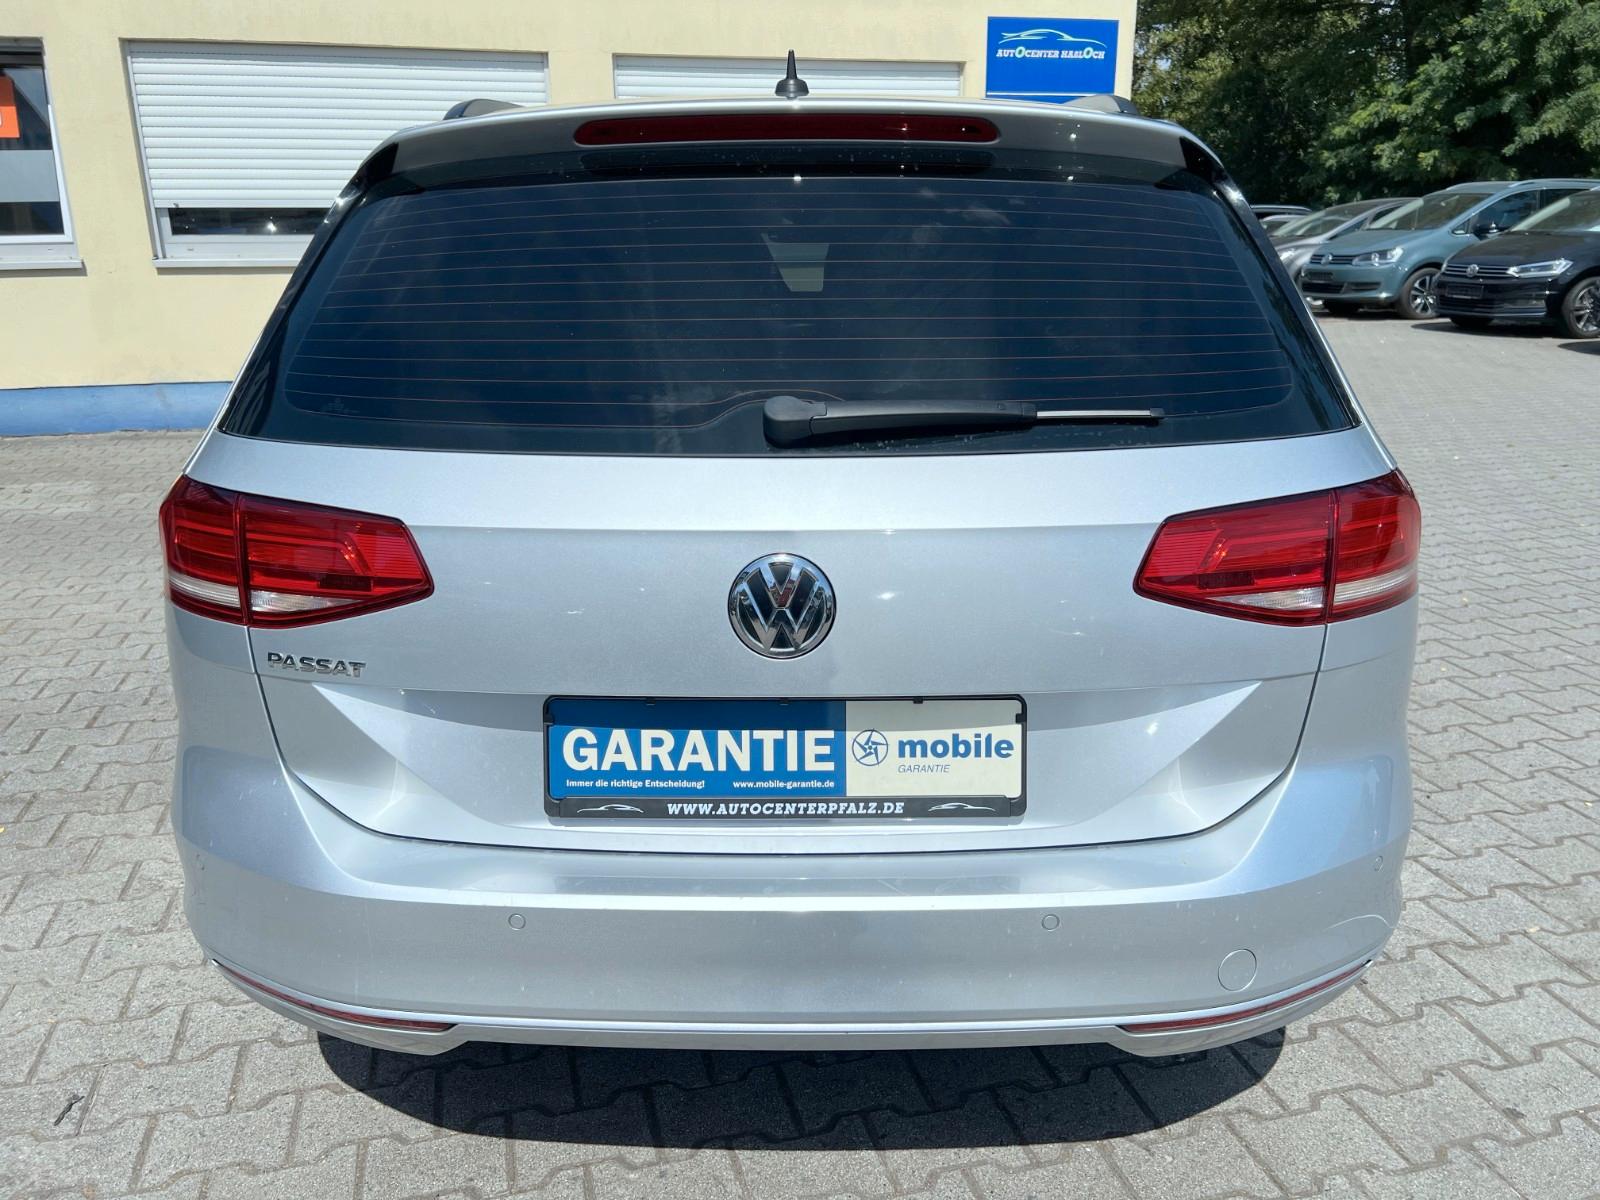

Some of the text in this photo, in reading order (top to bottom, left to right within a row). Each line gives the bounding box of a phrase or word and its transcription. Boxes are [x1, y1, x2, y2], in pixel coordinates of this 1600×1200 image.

[996, 46, 1059, 58] AUTOCENTER
[267, 651, 366, 677] PASSAT
[562, 728, 835, 772] GARANTIE
[897, 733, 1014, 759] mobile
[897, 764, 950, 774] GARANTIE
[566, 779, 705, 790] Immer die richtige Entscheidung!
[733, 780, 835, 790] www.mobile-garantie.de
[667, 802, 904, 815] WWW.AUTOCENTERPFALZ.DE
